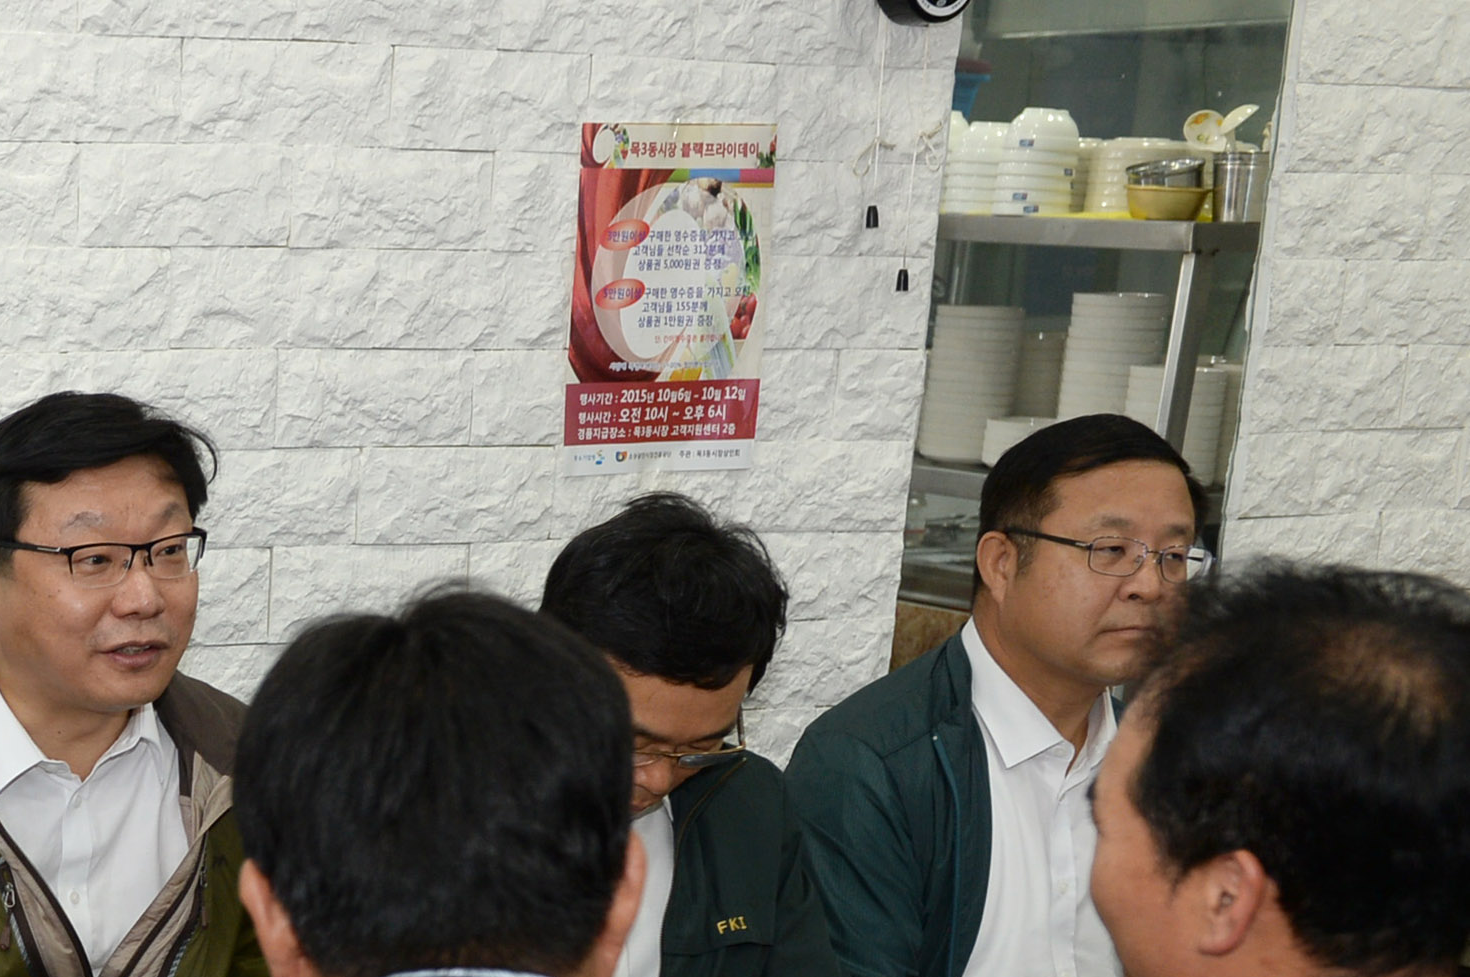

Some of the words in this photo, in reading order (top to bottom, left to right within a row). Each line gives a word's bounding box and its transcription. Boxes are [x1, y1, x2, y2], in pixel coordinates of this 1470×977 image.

[631, 141, 676, 158] 목3동시장
[681, 141, 759, 158] 블랙프라이데이
[580, 392, 613, 405] 행사기간
[620, 389, 655, 404] 2015년
[658, 388, 691, 403] 10월6일
[702, 387, 721, 401] 10월
[724, 386, 746, 401] 12일
[578, 411, 612, 425] 행사시간
[618, 407, 642, 423] 오전
[644, 406, 668, 422] 10시
[683, 406, 705, 421] 오후
[708, 404, 727, 420] 6시
[633, 426, 669, 438] 목3동시장
[671, 424, 721, 437] 고객지원센터
[716, 916, 747, 934] FKI
